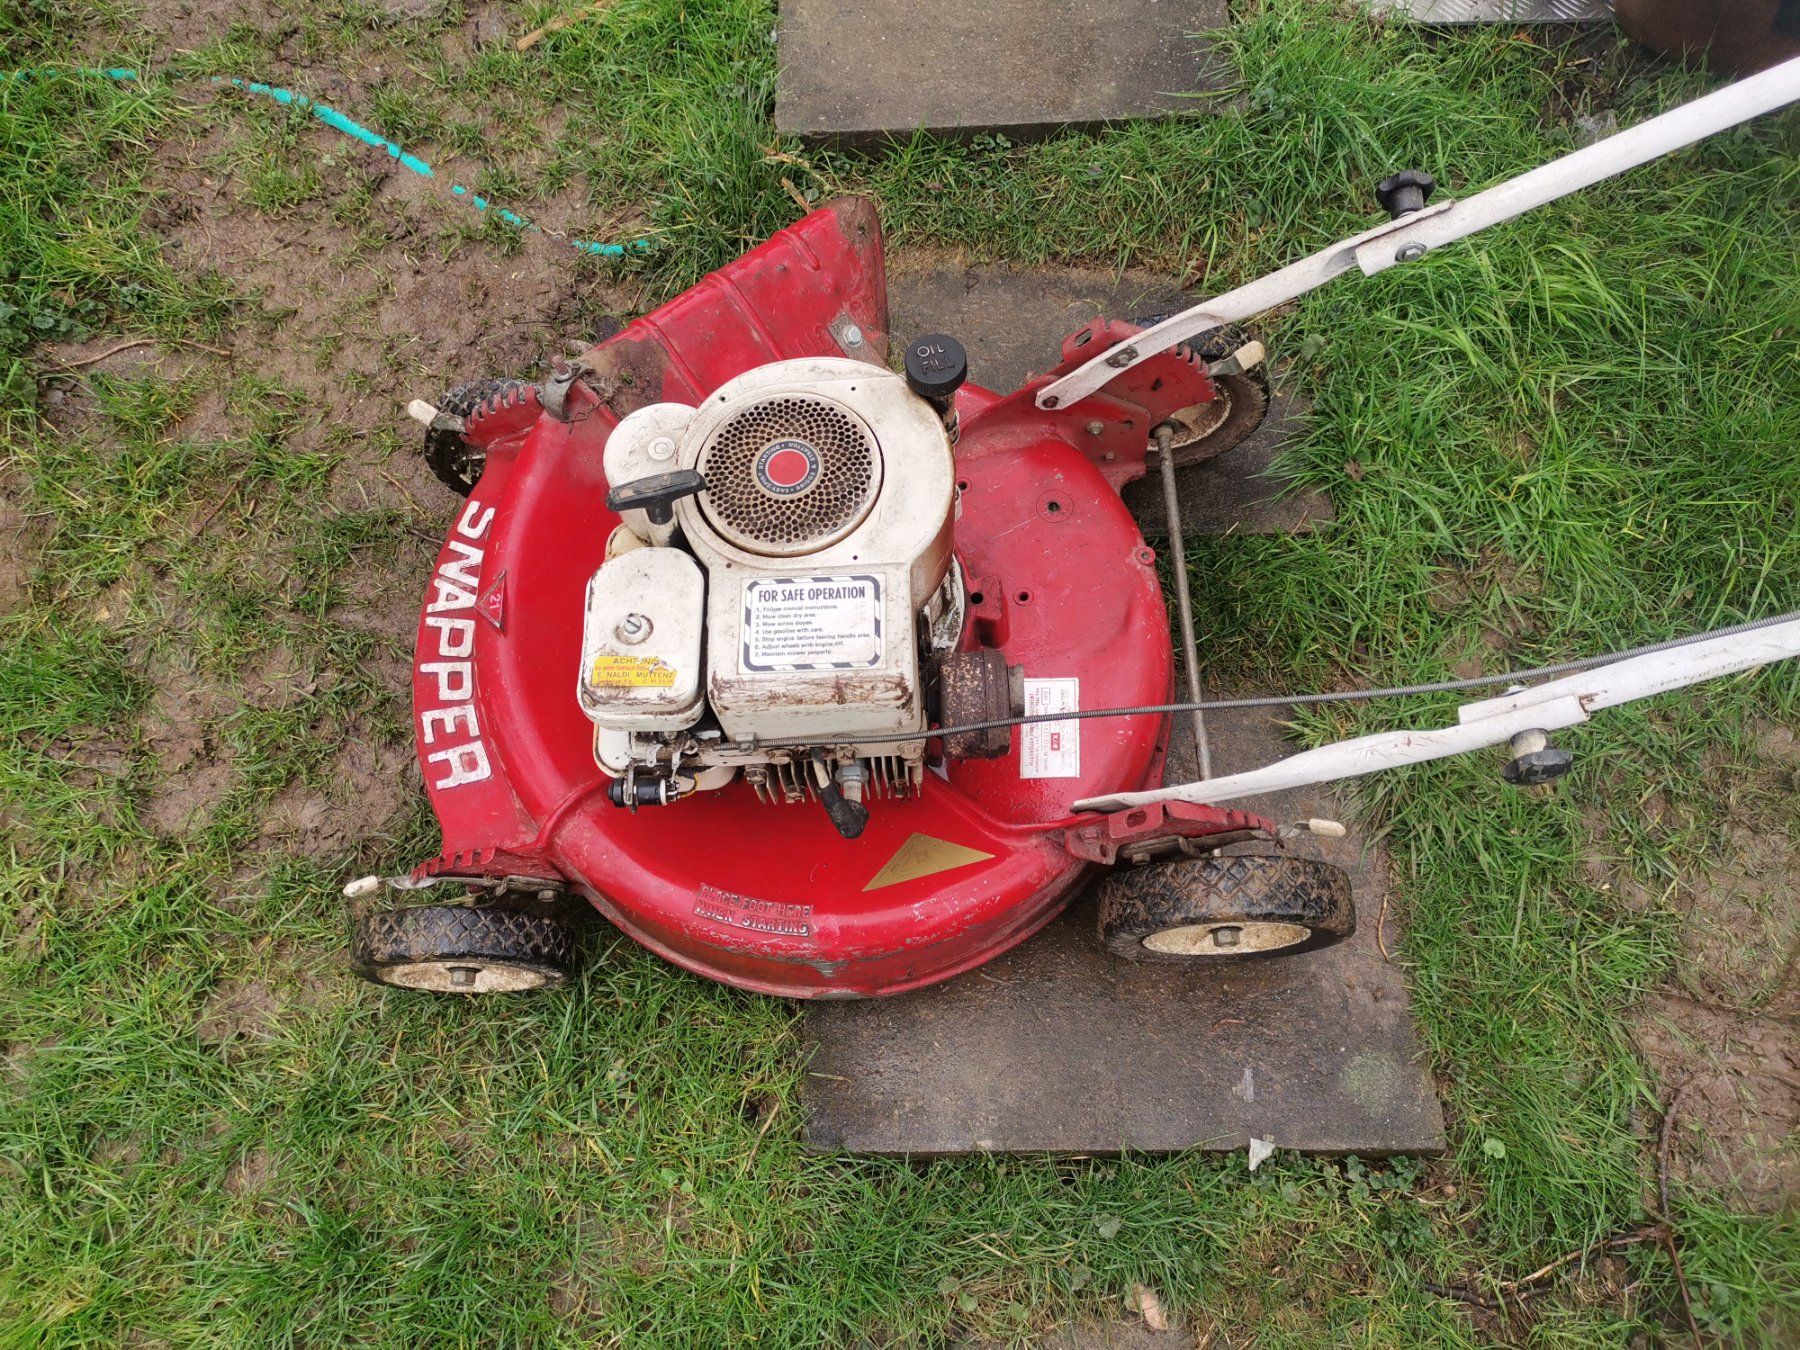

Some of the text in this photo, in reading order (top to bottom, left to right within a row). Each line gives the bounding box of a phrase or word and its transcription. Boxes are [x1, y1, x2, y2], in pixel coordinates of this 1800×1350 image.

[917, 344, 945, 357] OIL
[922, 359, 955, 375] FILL
[758, 444, 780, 470] STARTING
[489, 593, 501, 610] 21
[758, 586, 866, 602] FOR SAFE OPERATION
[420, 500, 495, 790] SNAPPER
[700, 885, 811, 918] PLACE FOOT HERE
[695, 902, 808, 934] WHEN STARTING
